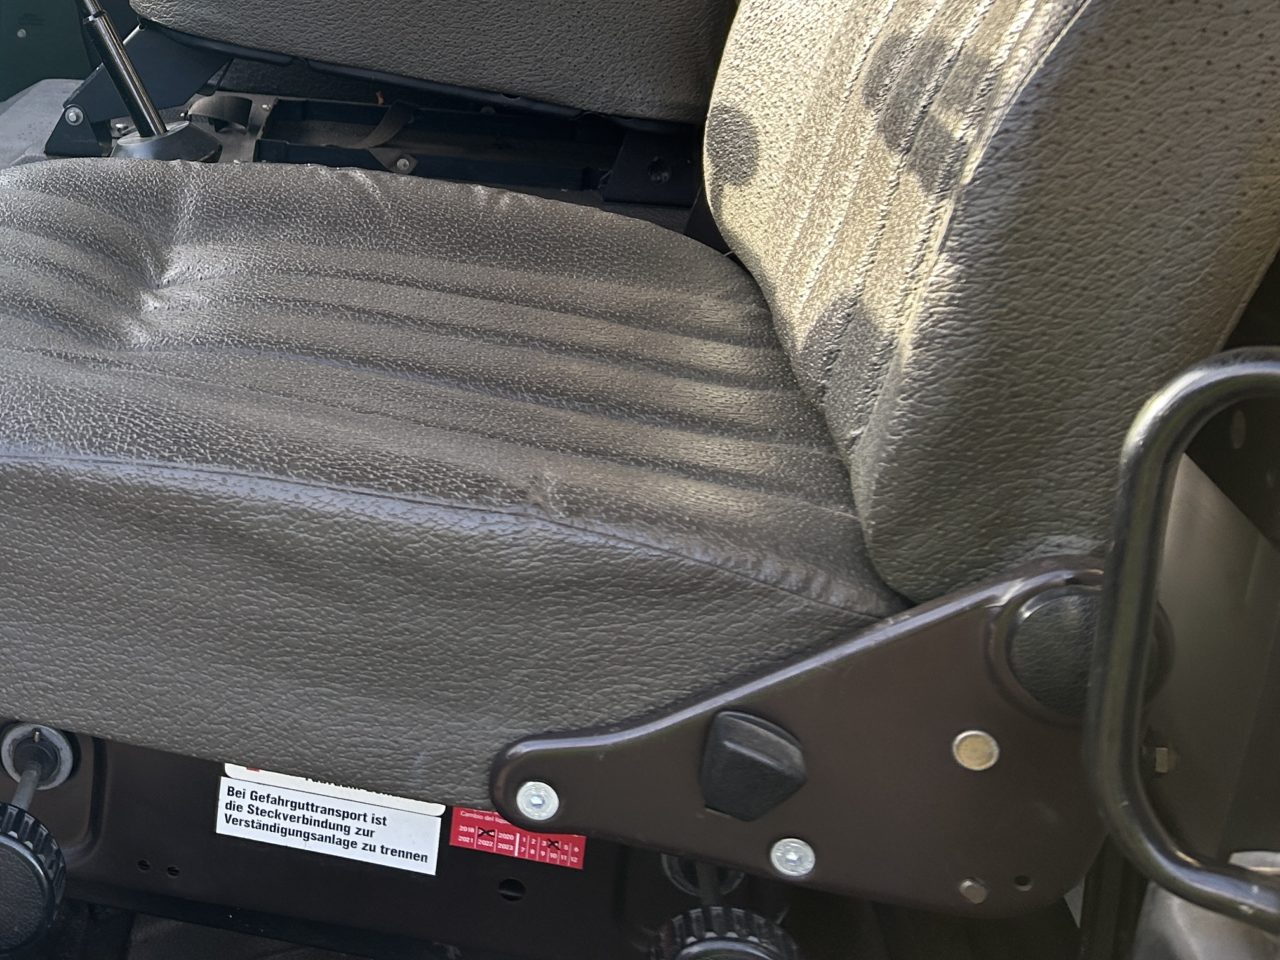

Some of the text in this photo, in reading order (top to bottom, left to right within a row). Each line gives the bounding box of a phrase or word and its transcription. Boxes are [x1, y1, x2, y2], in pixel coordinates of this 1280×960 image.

[225, 800, 376, 838] die Steckverbindung zur
[227, 785, 387, 826] Bei Gefahrguttransport ist
[224, 813, 428, 863] Verständigungsanlage zu trennen
[497, 842, 514, 851] 2023
[498, 832, 514, 841] 2020
